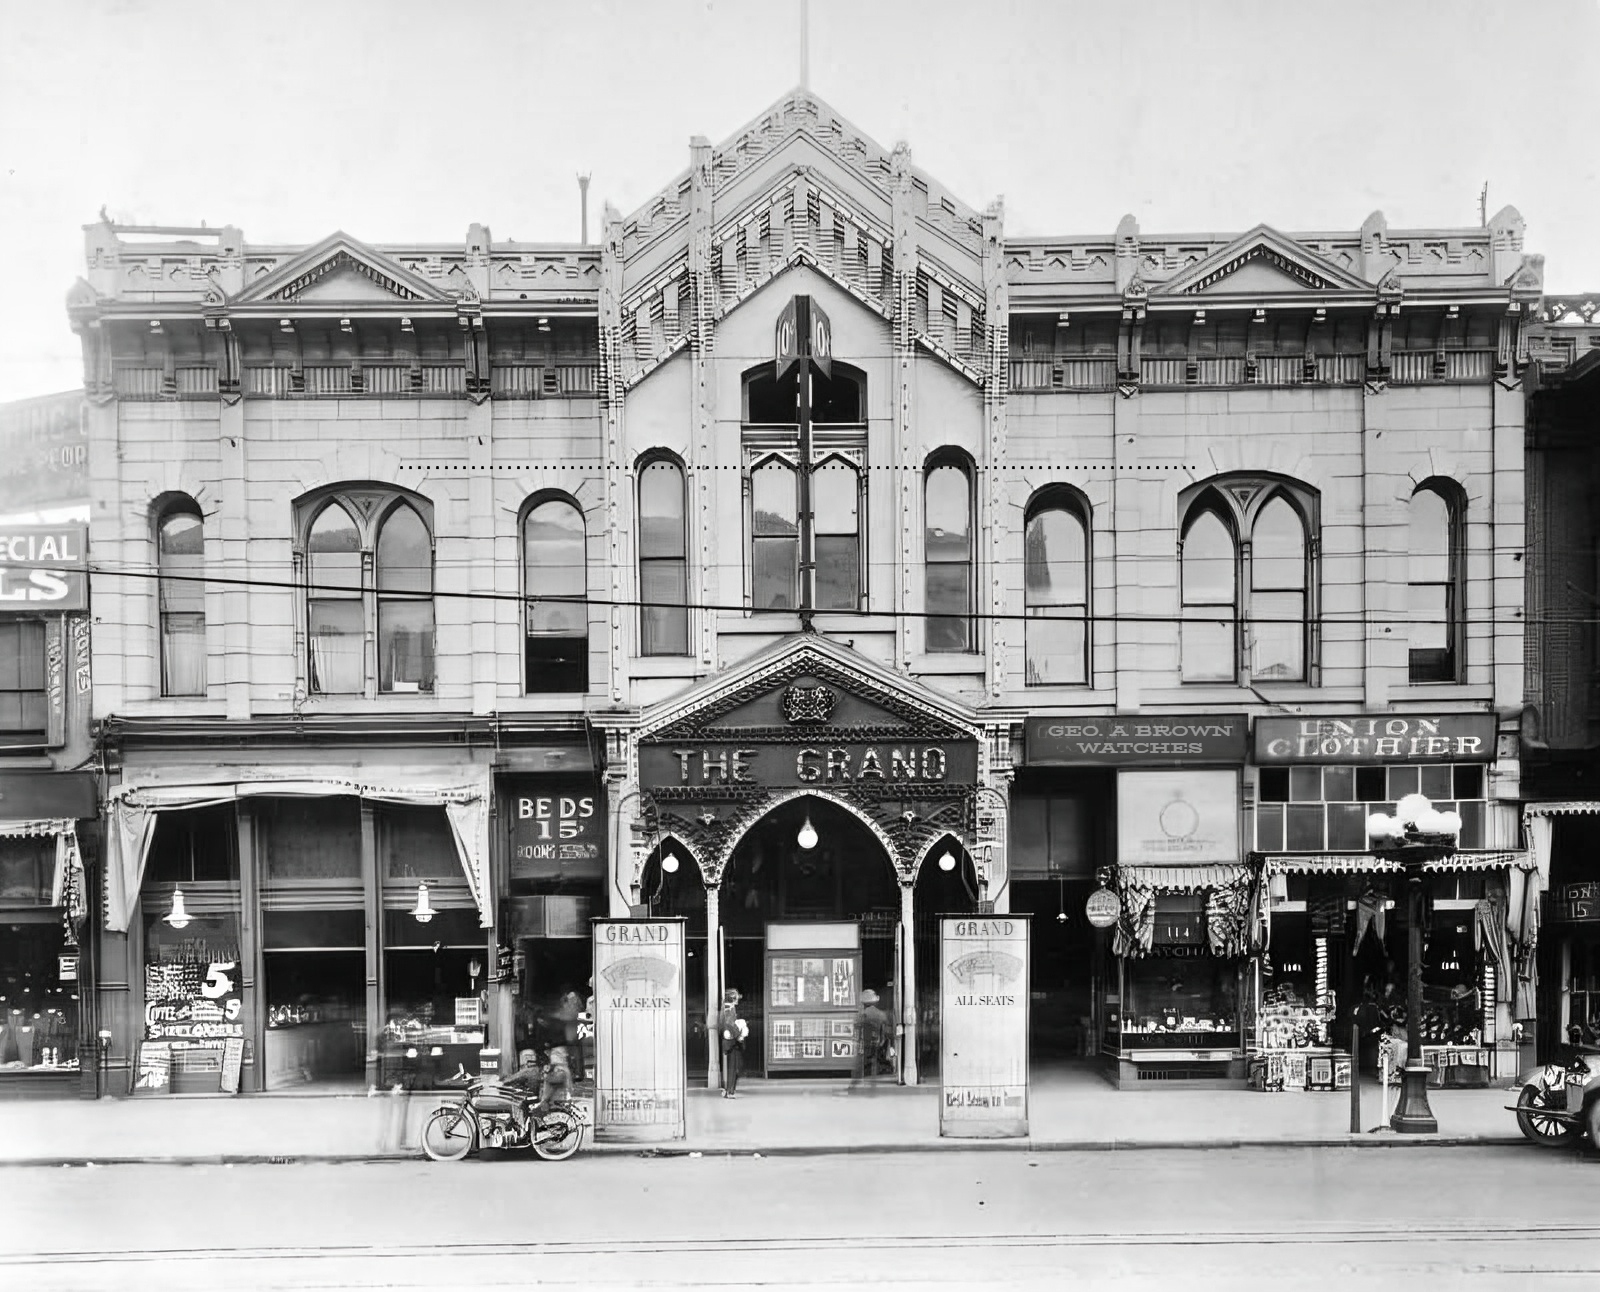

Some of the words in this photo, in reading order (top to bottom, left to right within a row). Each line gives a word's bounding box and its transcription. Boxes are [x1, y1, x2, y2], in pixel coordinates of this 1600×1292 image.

[1048, 725, 1103, 737] GEO.
[1110, 725, 1130, 737] A
[1135, 725, 1234, 737] BROWN
[1076, 742, 1203, 754] WATCHES
[1267, 736, 1485, 757] CLOTHIER
[672, 749, 758, 781] THE
[797, 748, 947, 781] GRAND
[605, 925, 669, 942] GRAND
[954, 921, 1014, 936] GRAND
[609, 997, 633, 1008] ALL
[634, 997, 671, 1008] SEATS
[954, 995, 977, 1006] ALL
[978, 995, 1015, 1006] SEATS
